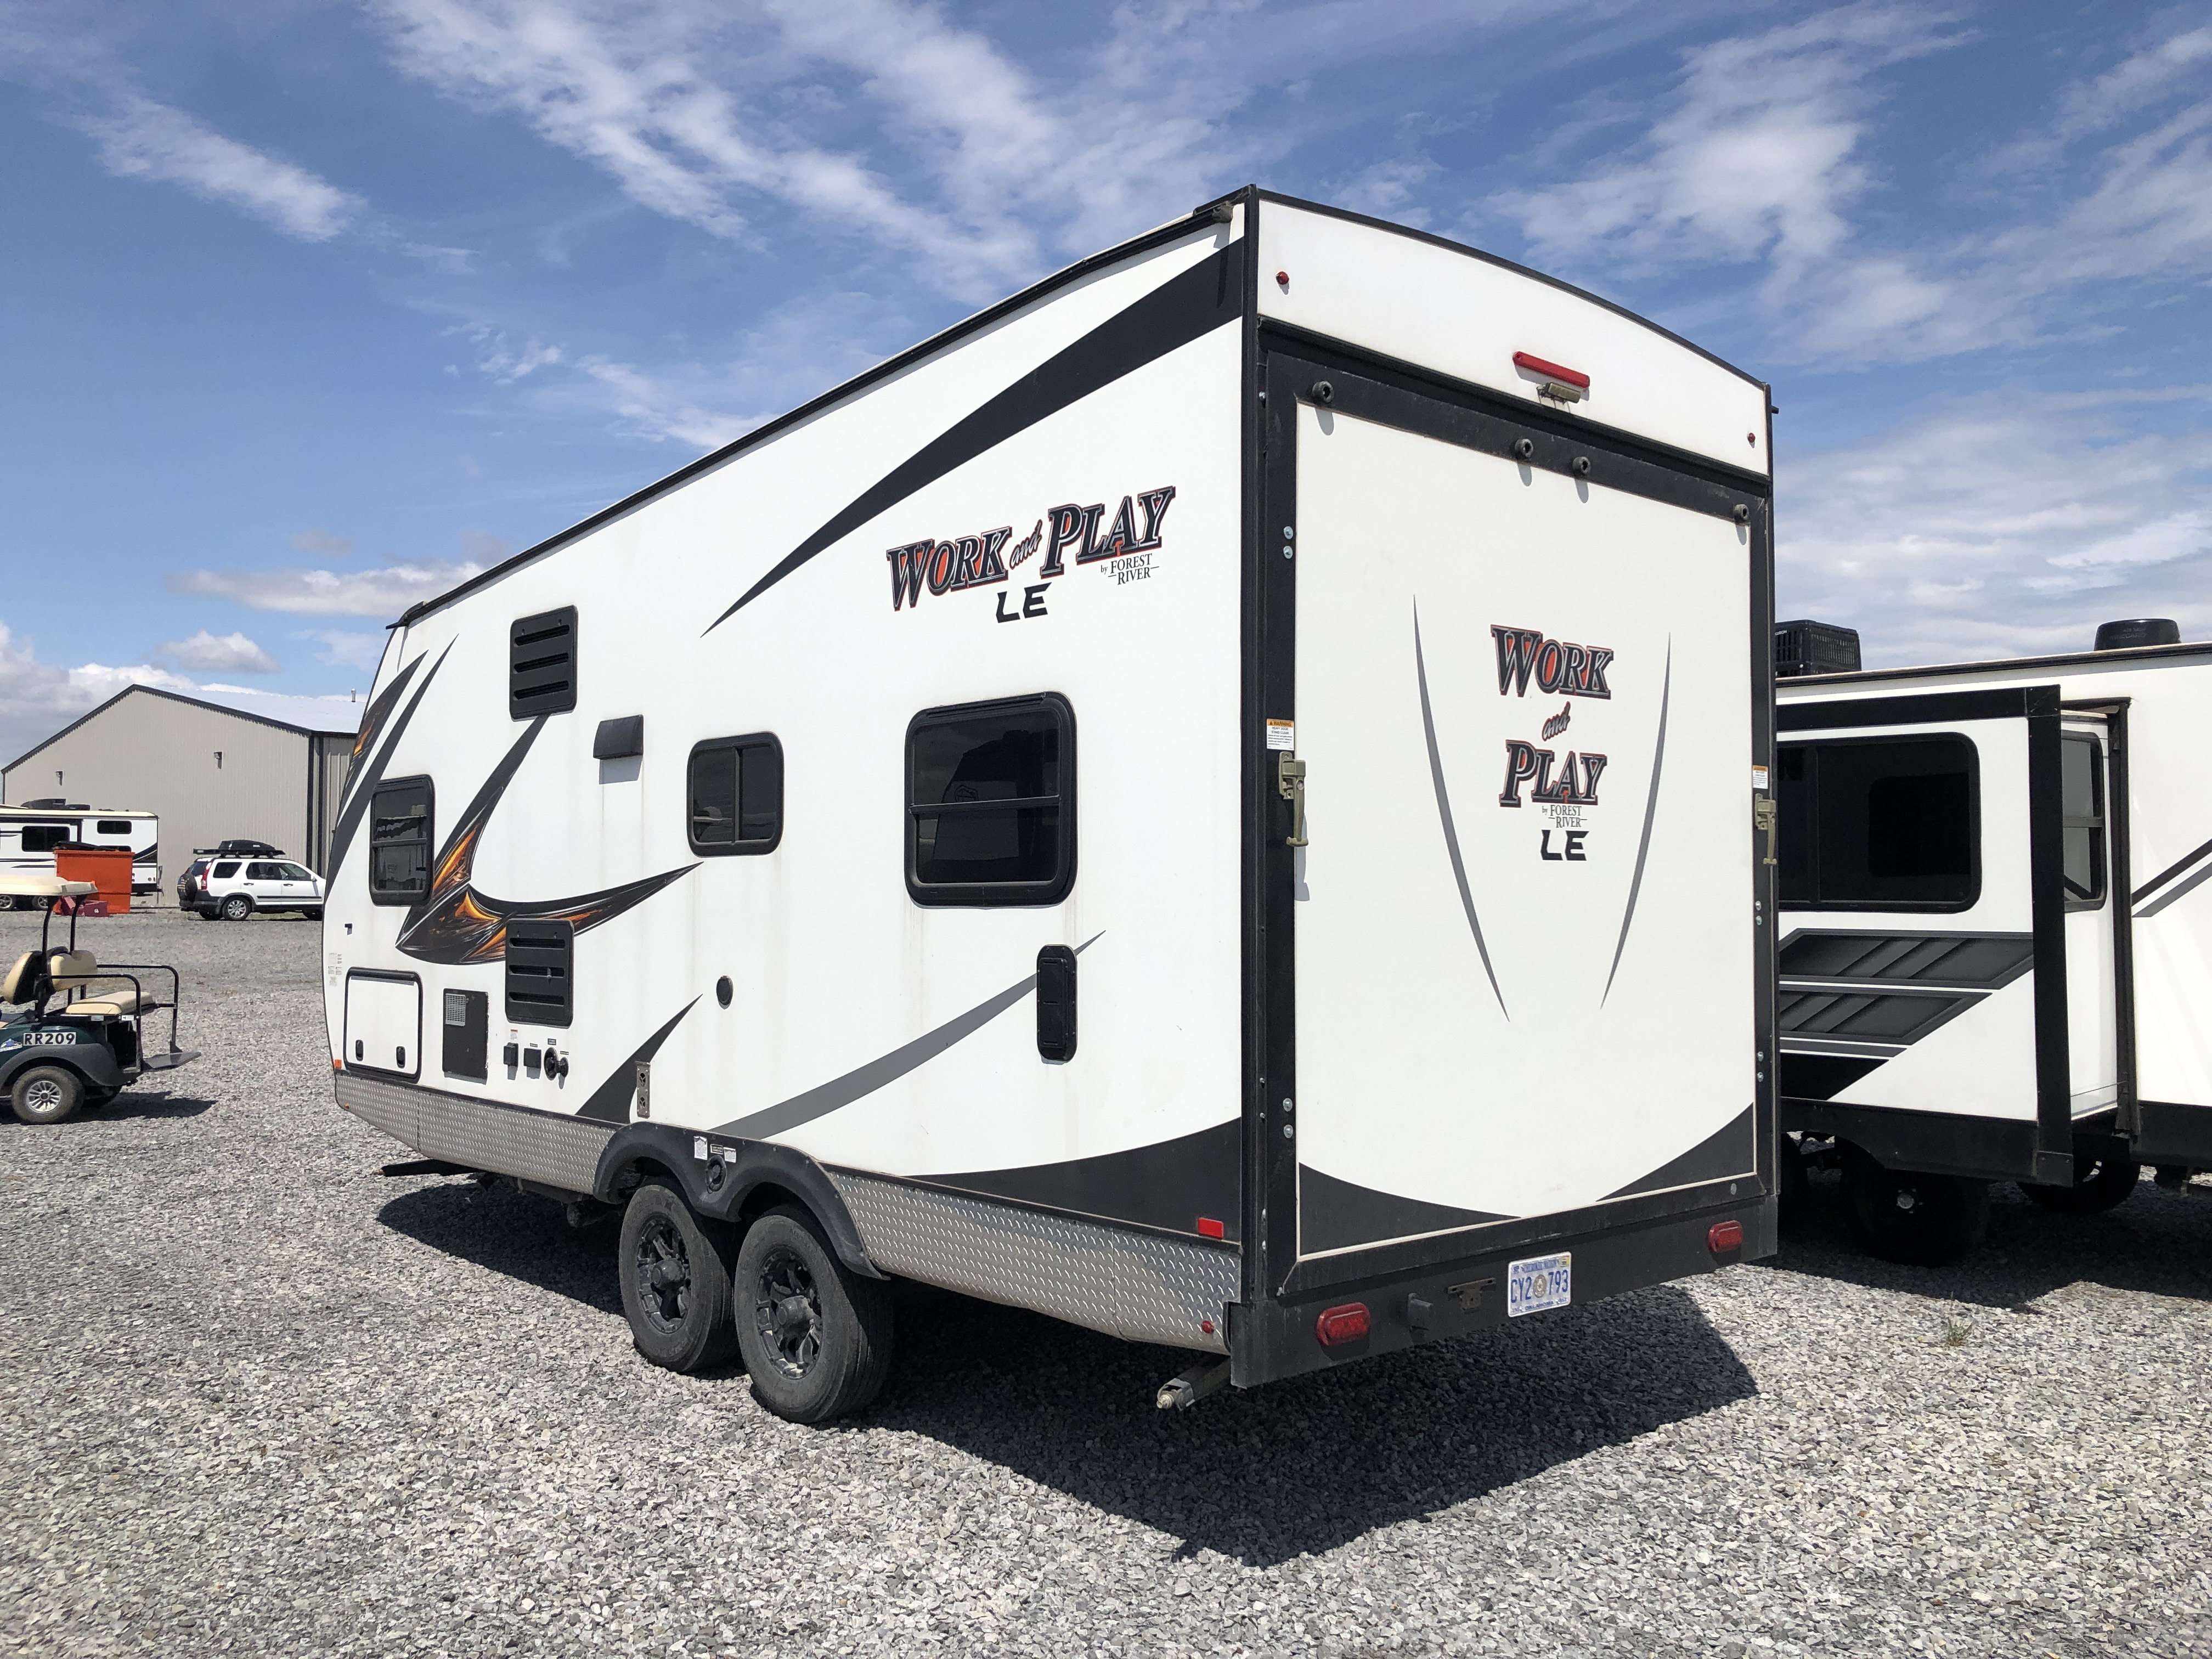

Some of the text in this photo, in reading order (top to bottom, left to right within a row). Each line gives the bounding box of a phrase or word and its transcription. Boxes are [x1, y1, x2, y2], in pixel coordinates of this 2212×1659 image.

[886, 486, 1176, 611] WORK and PLAY
[1101, 553, 1153, 575] by FOREST
[1117, 566, 1152, 585] RIVER
[996, 582, 1052, 623] LE
[1491, 624, 1614, 699] WORK
[1542, 701, 1571, 741] and
[1499, 739, 1607, 808] PLAY
[1542, 804, 1582, 816] by FOREST
[1555, 816, 1582, 828] RIVER
[1540, 830, 1589, 861] LE
[24, 1032, 75, 1045] RR209
[1510, 1269, 1568, 1303] CY2 793
